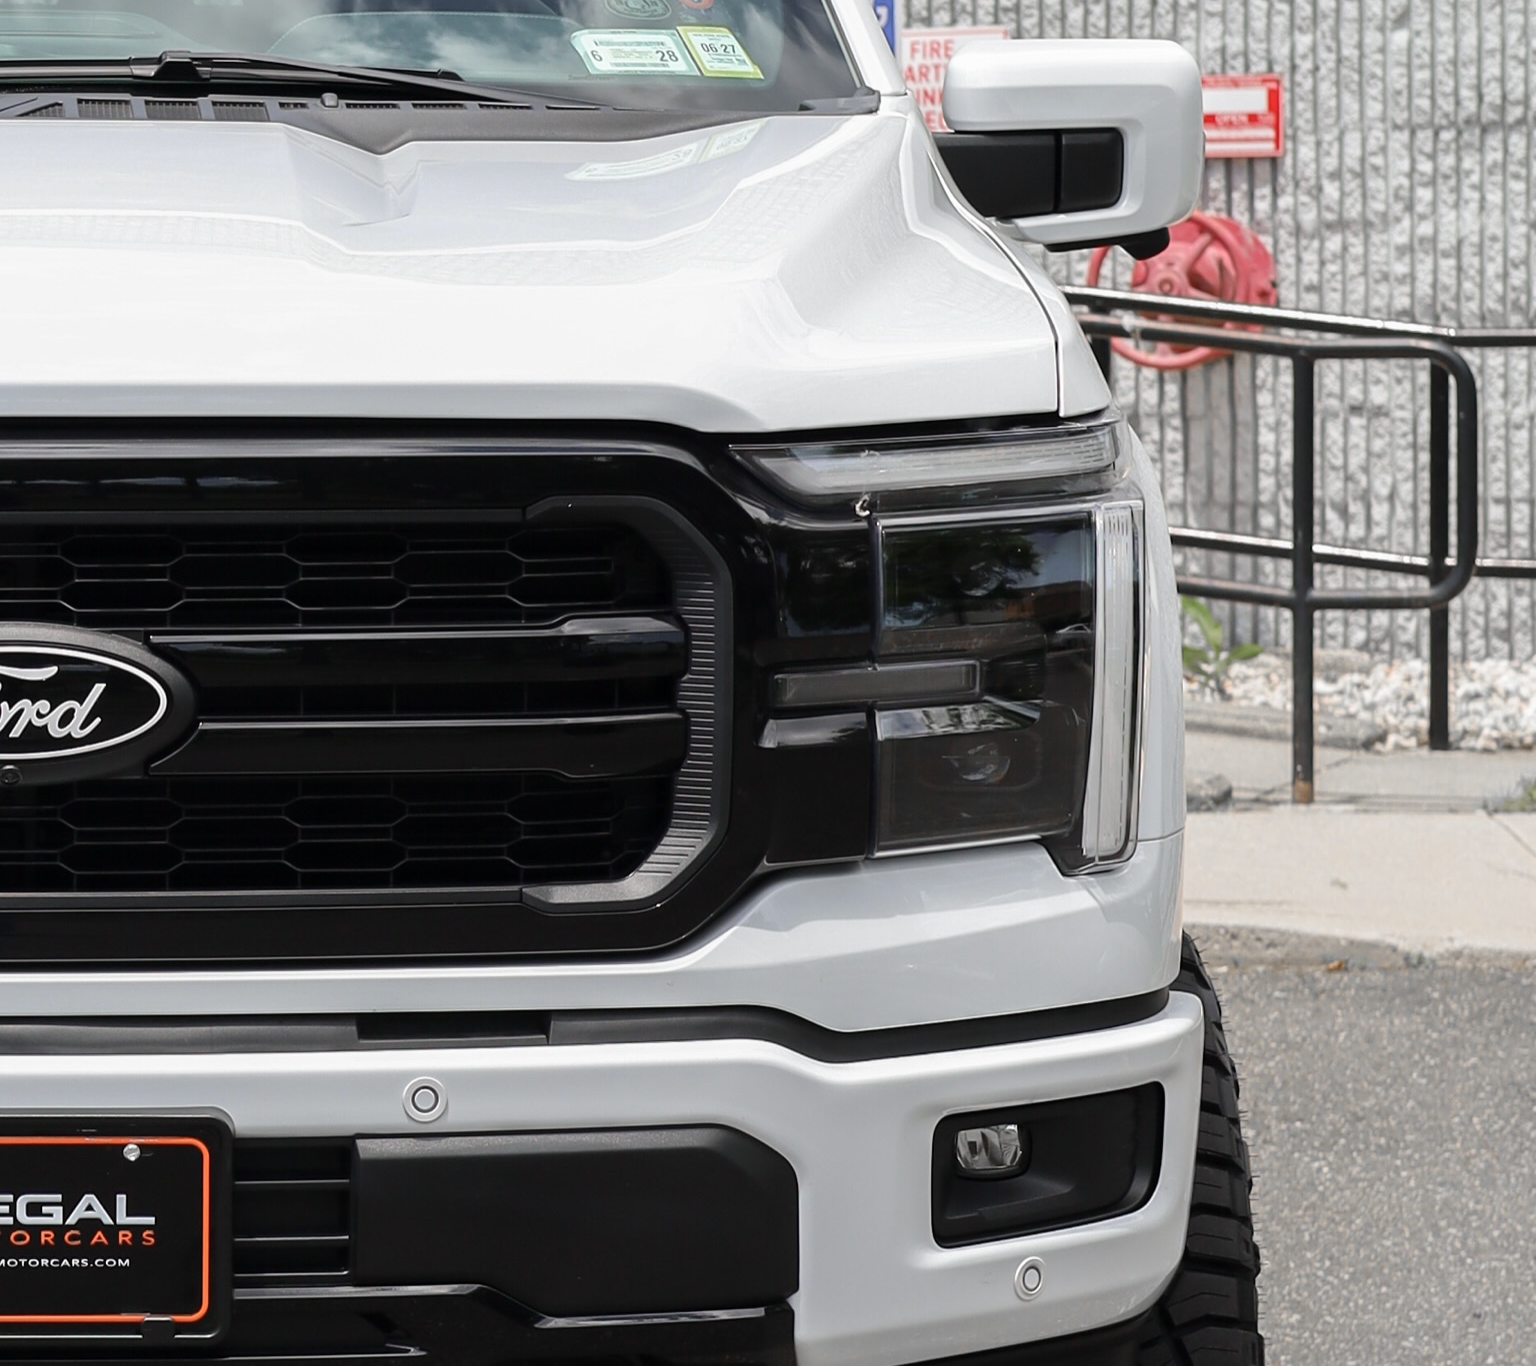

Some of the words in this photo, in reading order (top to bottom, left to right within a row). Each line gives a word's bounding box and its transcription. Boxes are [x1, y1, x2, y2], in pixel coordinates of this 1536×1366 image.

[590, 49, 603, 63] 6
[655, 49, 679, 63] 28
[910, 40, 954, 60] FIRE
[903, 63, 947, 83] ART
